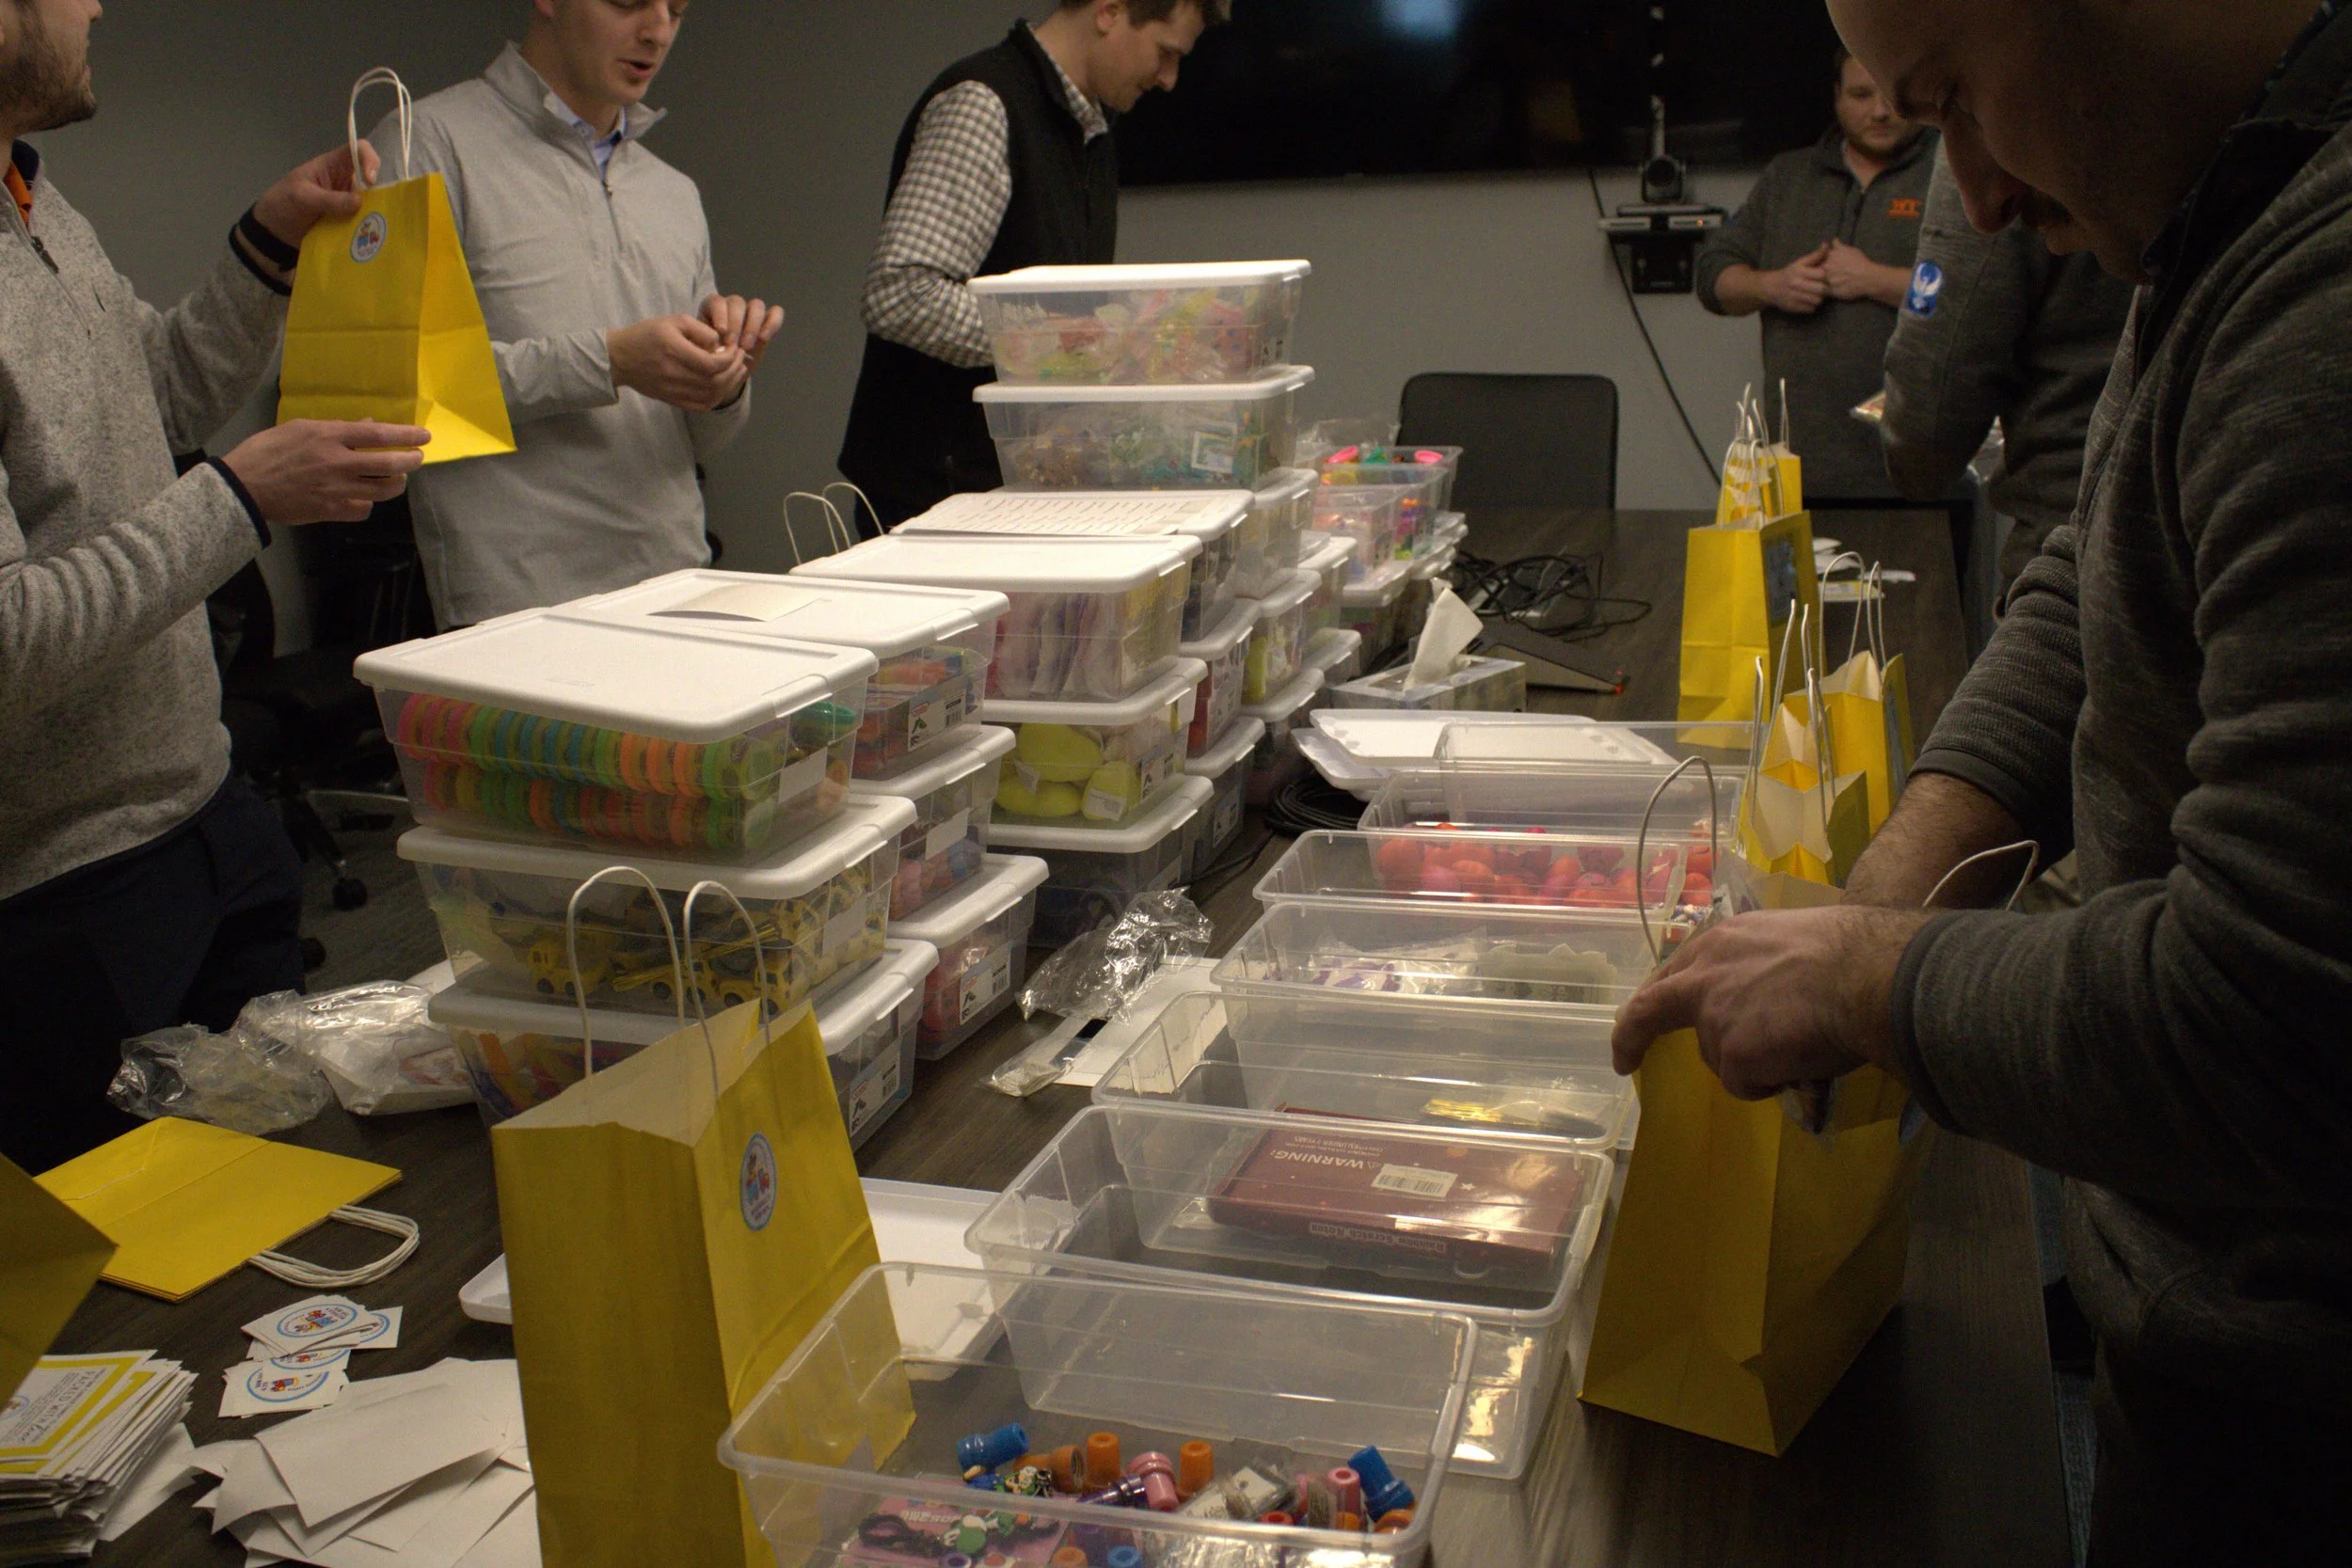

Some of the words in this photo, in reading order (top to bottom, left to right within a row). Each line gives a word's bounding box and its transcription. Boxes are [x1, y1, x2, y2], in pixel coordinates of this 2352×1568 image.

[1270, 1149, 1363, 1169] WARNING:
[1311, 1224, 1347, 1237] Notes
[1350, 1229, 1393, 1244] Scratch
